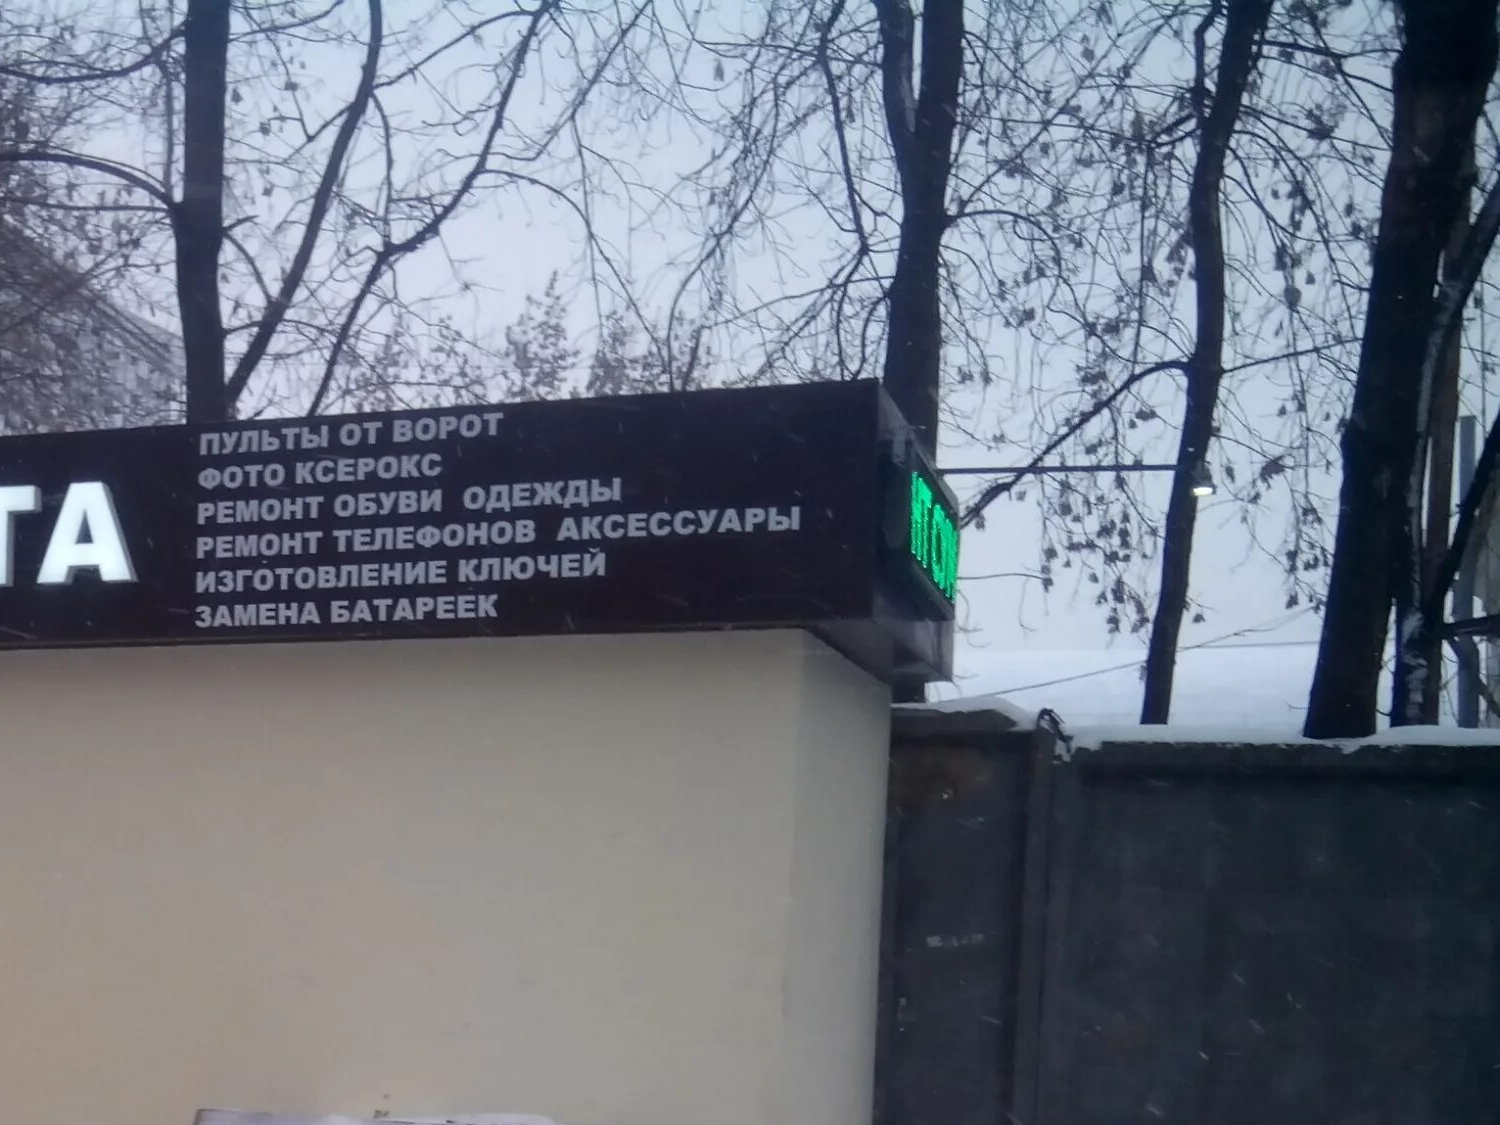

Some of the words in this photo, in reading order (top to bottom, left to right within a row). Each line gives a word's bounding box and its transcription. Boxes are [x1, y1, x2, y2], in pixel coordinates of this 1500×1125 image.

[200, 425, 329, 456] ПУЛЬТЫ
[339, 421, 383, 447] ОТ
[393, 412, 504, 443] ВОРОТ
[198, 463, 286, 490] ФОТО
[295, 453, 443, 485] КСЕРОКС
[197, 496, 324, 525] РЕМОНТ
[333, 489, 443, 518] ОБУВИ
[463, 477, 621, 513] ОДЕЖДЫ
[196, 531, 323, 560] РЕМОНТ
[332, 519, 536, 553] ТЕЛЕФОНОВ
[556, 506, 801, 542] АКСЕССУАРЫ
[195, 560, 448, 594] ИЗГОТОВЛЕНИЕ
[458, 548, 606, 583] КЛЮЧЕЙ
[195, 602, 321, 629] ЗАМЕНА
[330, 594, 498, 623] БАТАРЕЕК
